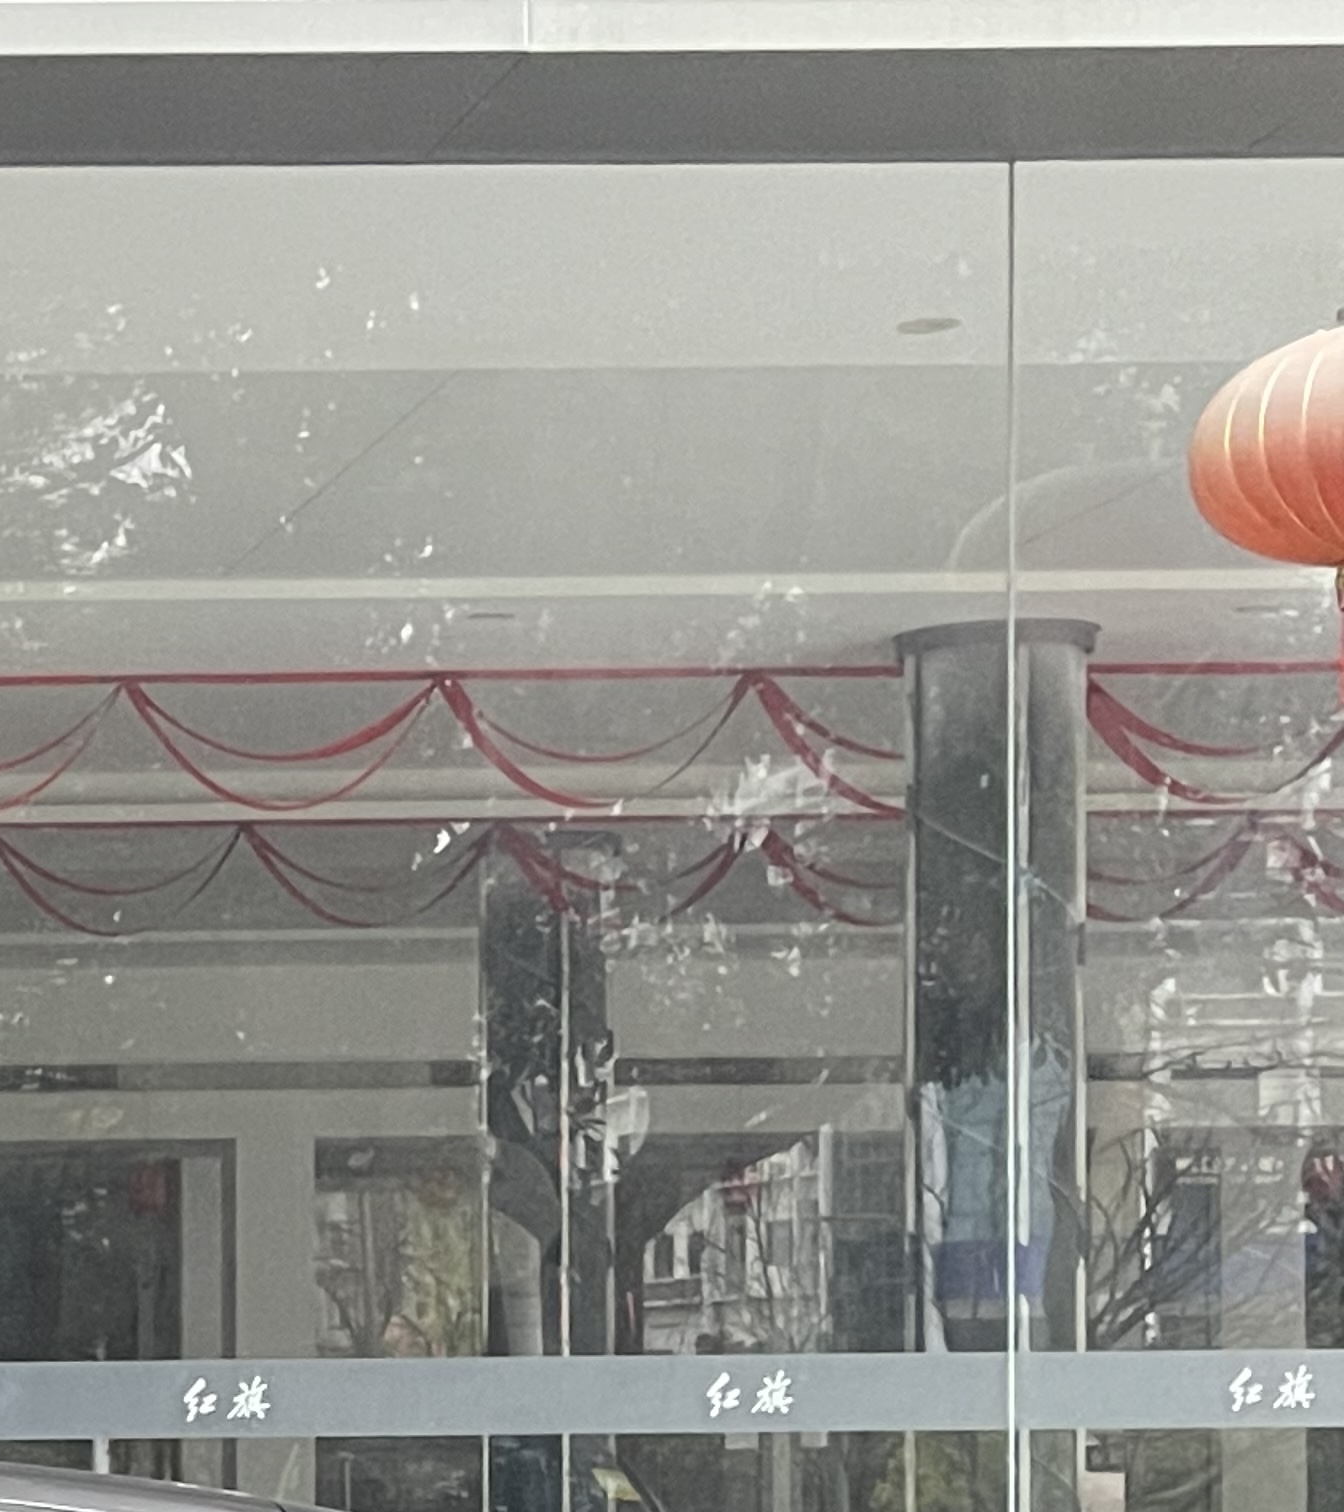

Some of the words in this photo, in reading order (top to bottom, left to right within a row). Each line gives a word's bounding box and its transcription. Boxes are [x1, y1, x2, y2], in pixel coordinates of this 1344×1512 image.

[184, 1376, 270, 1422] 红旗
[707, 1370, 793, 1417] 红旗
[1230, 1365, 1315, 1411] 红旗
